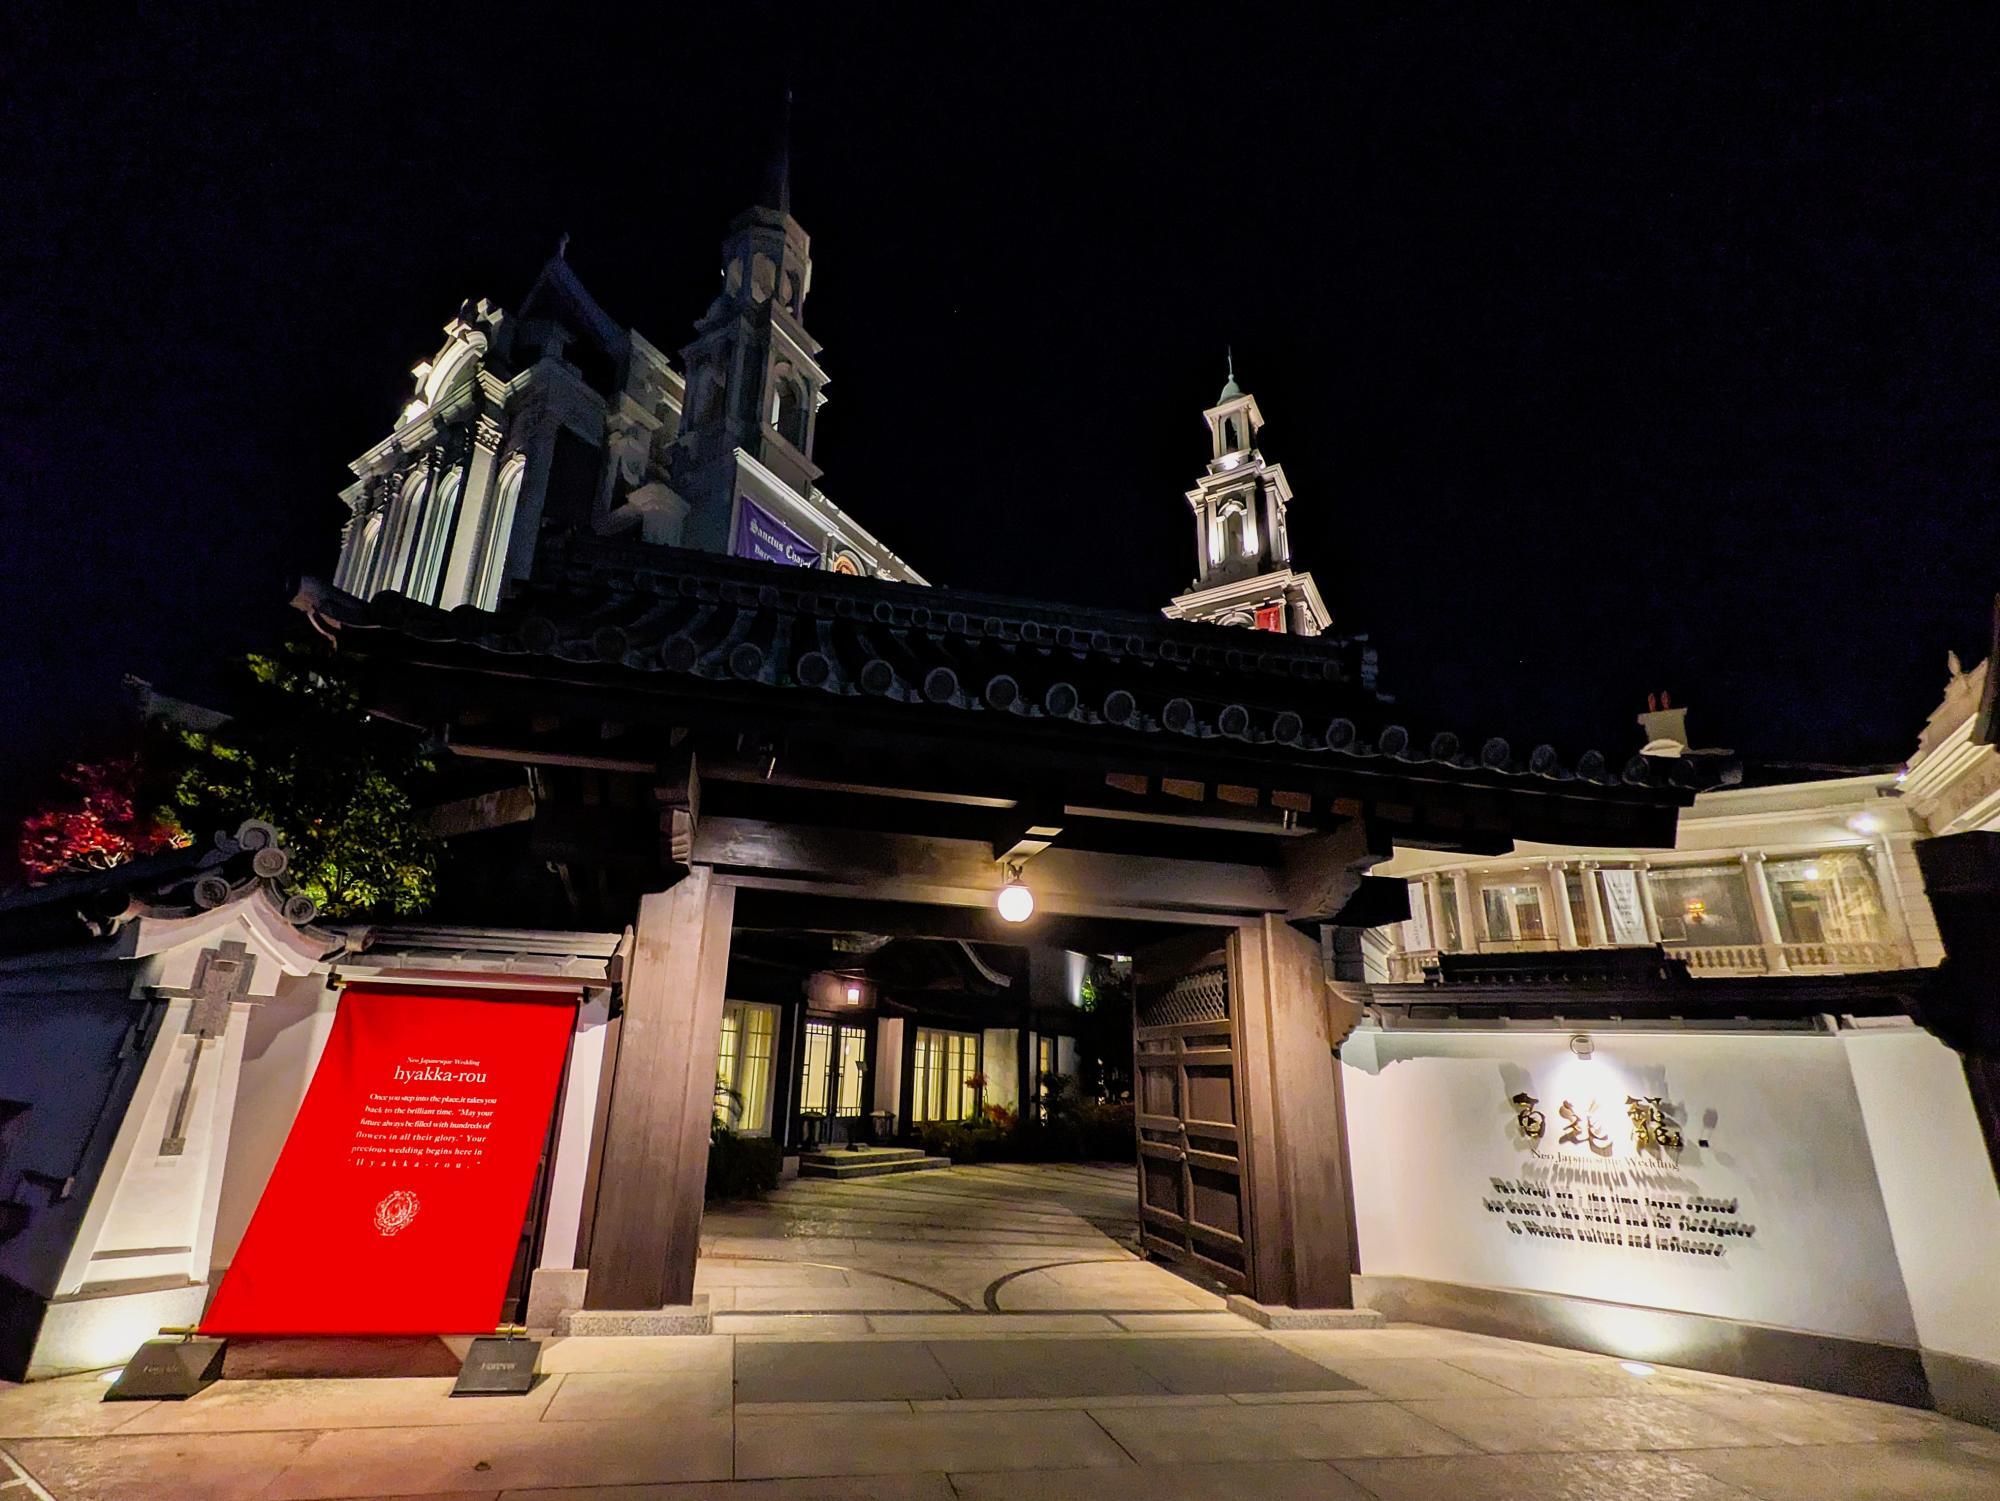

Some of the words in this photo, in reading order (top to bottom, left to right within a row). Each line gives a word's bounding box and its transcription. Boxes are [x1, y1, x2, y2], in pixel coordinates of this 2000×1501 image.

[750, 518, 784, 552] Sanctus
[393, 1065, 487, 1085] hyakka-rou
[484, 1098, 497, 1106] you
[407, 1107, 435, 1115] brilliant
[476, 1111, 494, 1119] your
[449, 1121, 482, 1129] hundreds
[482, 1122, 492, 1130] of
[355, 1130, 387, 1140] flowers
[399, 1133, 411, 1141] all
[412, 1133, 433, 1141] their
[466, 1134, 487, 1143] Your
[351, 1145, 387, 1154] precious
[388, 1146, 424, 1156] wedding
[426, 1147, 452, 1156] begins
[454, 1147, 472, 1156] here
[1495, 1184, 1516, 1194] The
[1518, 1185, 1551, 1199] Meiji
[1556, 1192, 1573, 1200] era
[1588, 1192, 1606, 1203] the
[1611, 1193, 1638, 1205] time
[1645, 1197, 1682, 1211] Japan
[1686, 1199, 1737, 1214] opened
[1487, 1203, 1505, 1213] her
[1510, 1205, 1541, 1217] doors
[1546, 1208, 1557, 1218] to
[1562, 1210, 1580, 1221] the
[1585, 1213, 1620, 1225] world
[1626, 1217, 1648, 1228] and
[1652, 1220, 1671, 1229] the
[1678, 1221, 1753, 1238] floodgates
[1510, 1225, 1523, 1235] to
[1526, 1226, 1575, 1241] Western
[1580, 1231, 1623, 1246] culture
[1628, 1239, 1651, 1249] and
